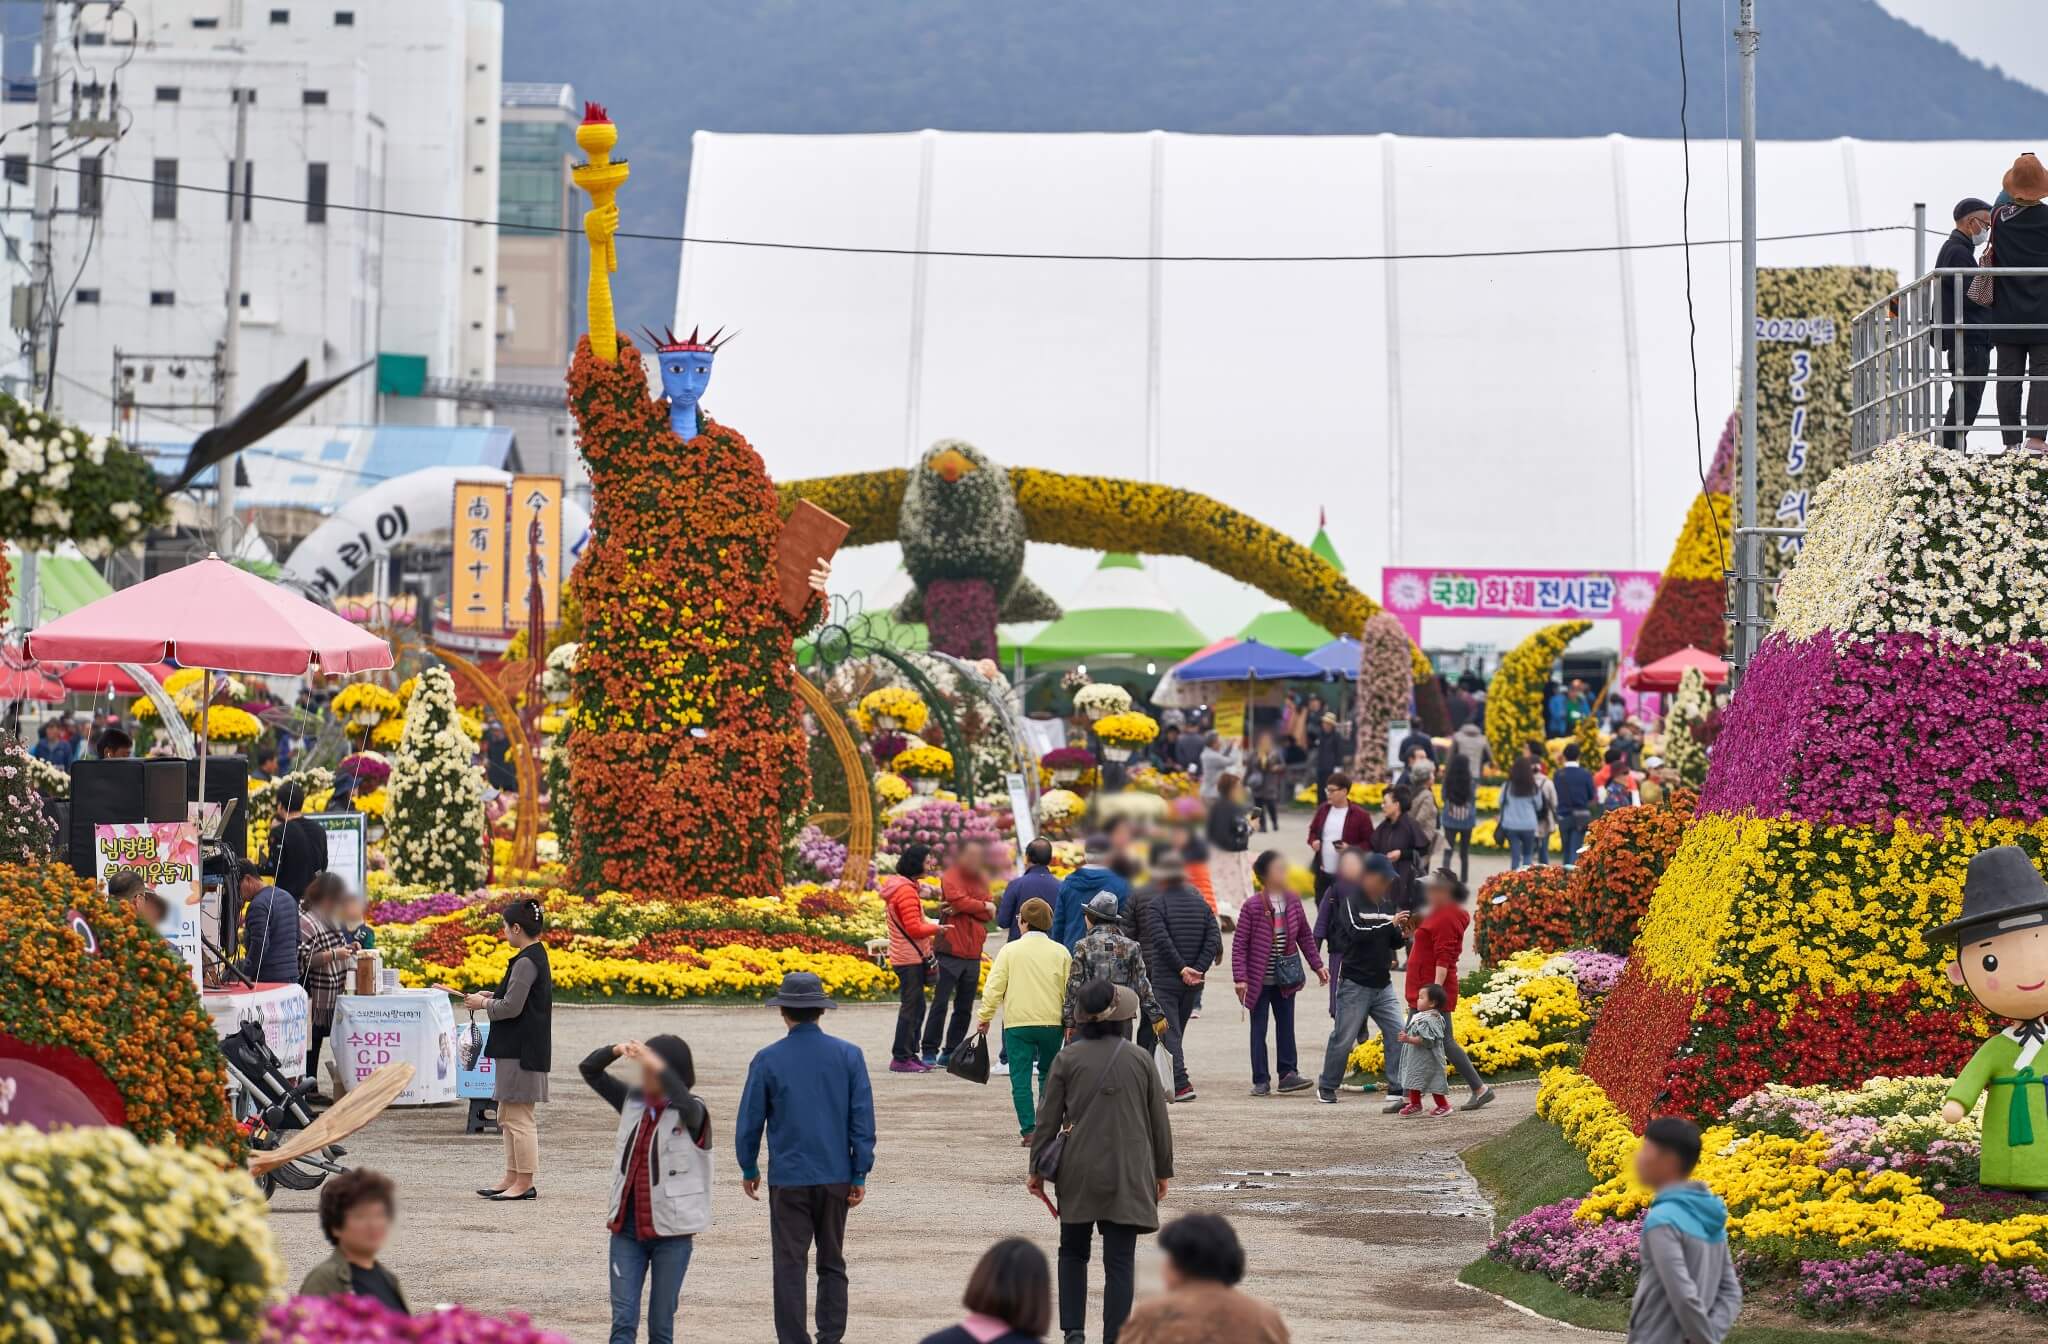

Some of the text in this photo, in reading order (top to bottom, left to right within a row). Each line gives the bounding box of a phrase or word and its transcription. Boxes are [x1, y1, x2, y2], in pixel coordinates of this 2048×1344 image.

[467, 495, 489, 612] 尚有十二
[1431, 578, 1478, 607] 국화
[100, 837, 158, 861] 심장병
[346, 1031, 401, 1047] 수와진
[357, 1049, 391, 1065] C.D
